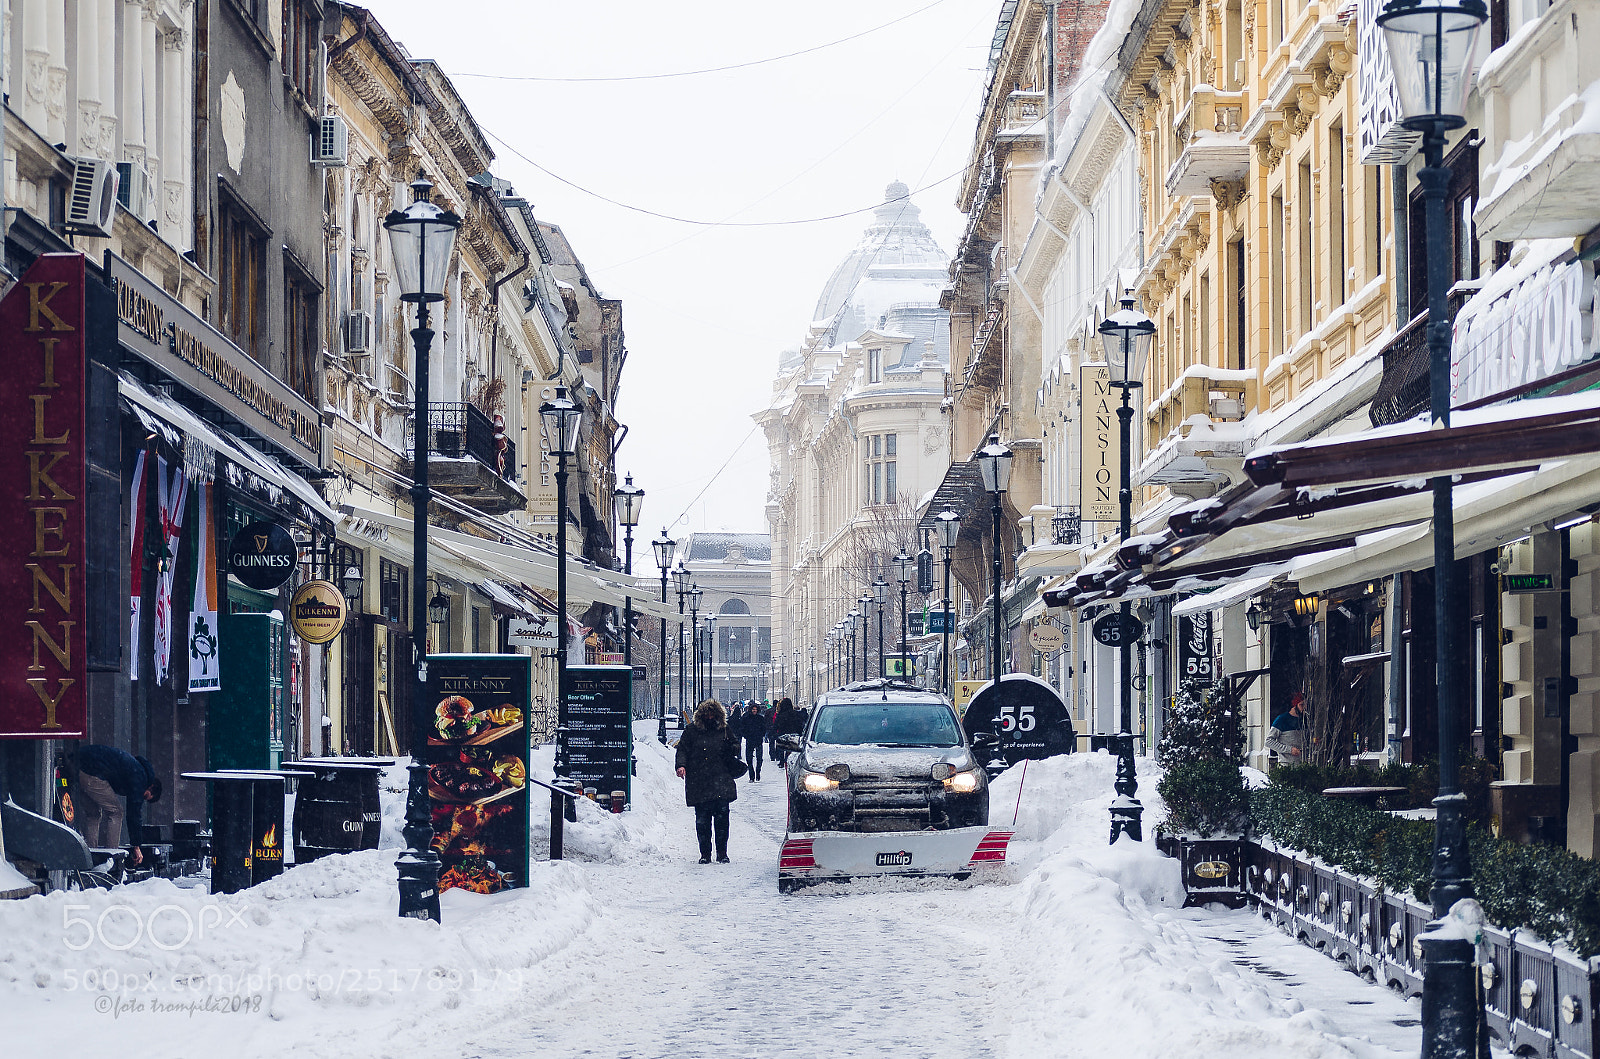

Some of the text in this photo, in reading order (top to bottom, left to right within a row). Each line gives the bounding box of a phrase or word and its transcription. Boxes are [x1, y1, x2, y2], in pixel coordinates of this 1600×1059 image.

[117, 277, 163, 346] KILKENNY
[1094, 380, 1112, 502] MANSION
[23, 281, 76, 729] KILKENNY
[233, 552, 291, 567] GUINNESS
[1523, 577, 1539, 587] WC
[298, 606, 339, 616] KILKENNY
[515, 626, 559, 638] emilia
[1101, 628, 1120, 642] 55
[1187, 657, 1211, 675] 55
[444, 680, 507, 690] KILKENNY
[1000, 705, 1036, 732] 55
[256, 848, 283, 858] BURN
[878, 851, 911, 866] Hilltip
